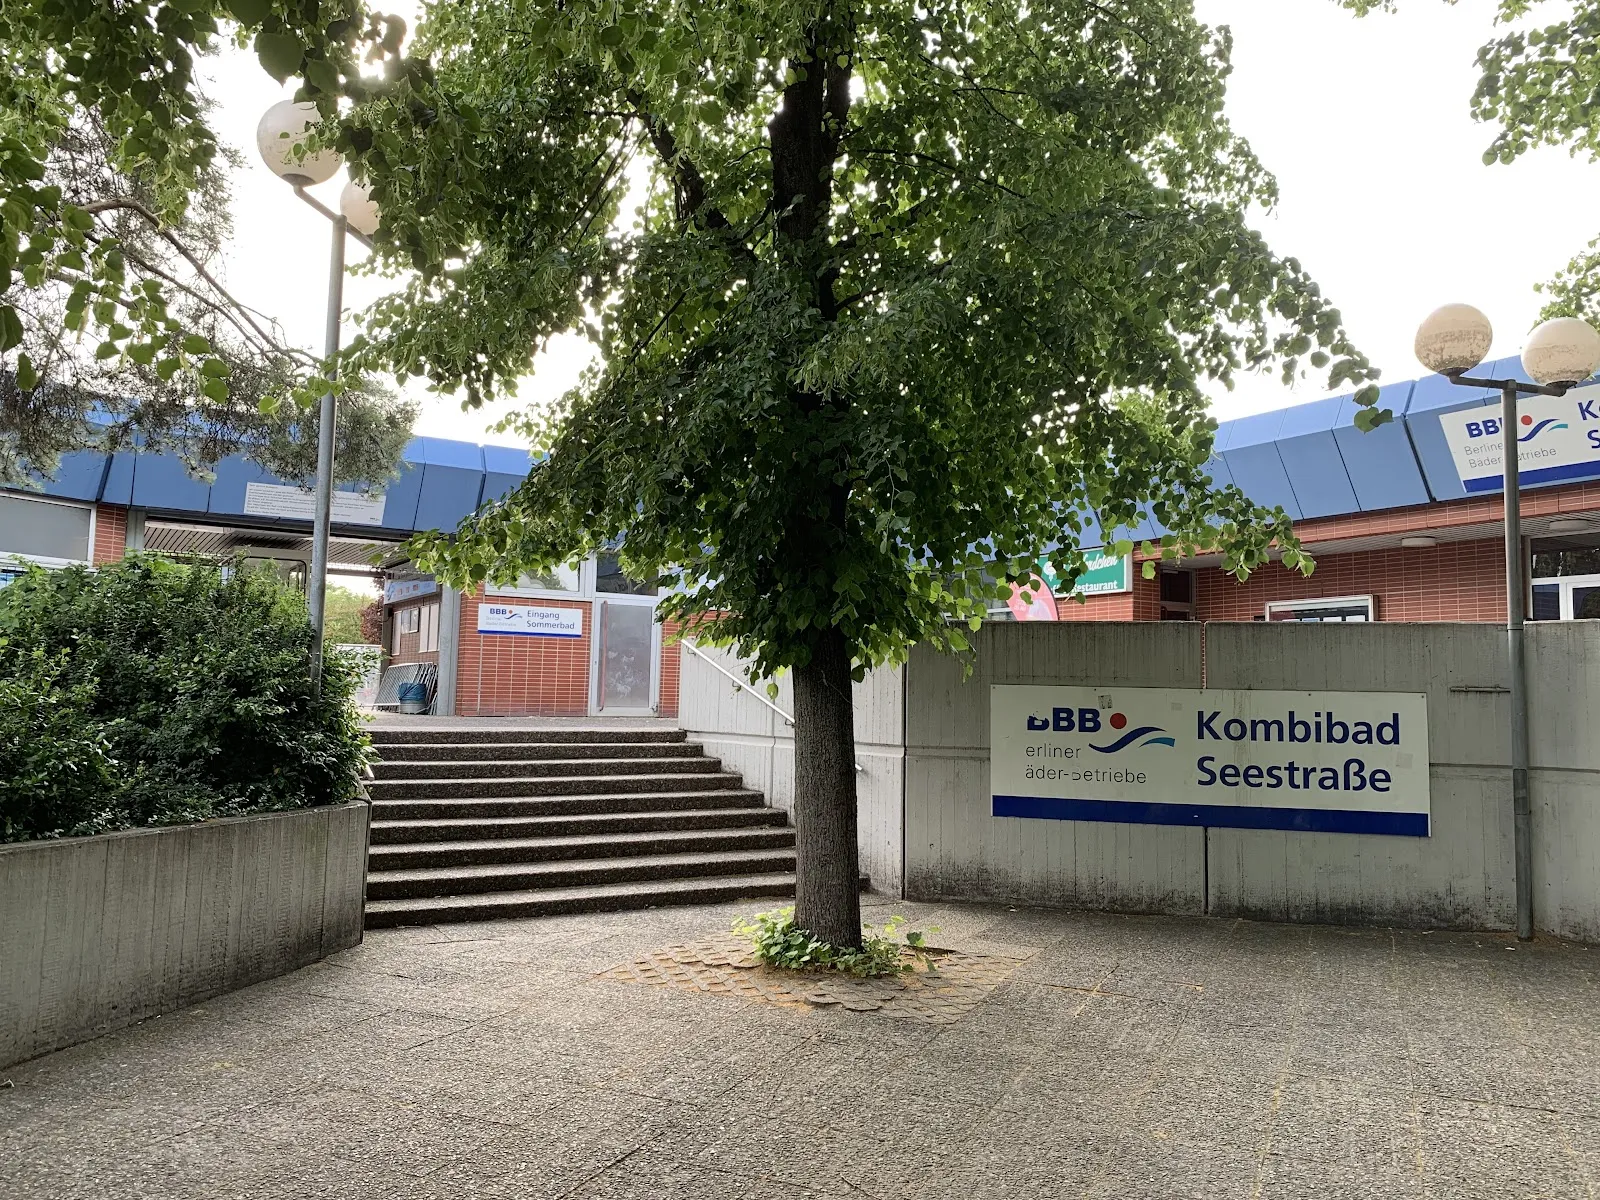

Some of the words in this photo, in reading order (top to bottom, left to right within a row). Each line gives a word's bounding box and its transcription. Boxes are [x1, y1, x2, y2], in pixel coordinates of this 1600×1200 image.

[1578, 400, 1600, 421] K
[1465, 417, 1502, 438] BB
[1464, 441, 1503, 456] Berline
[526, 620, 575, 629] Sommerbad
[527, 609, 560, 620] Eingang
[1197, 710, 1401, 745] Kombibad
[1197, 755, 1392, 793] Seestraße
